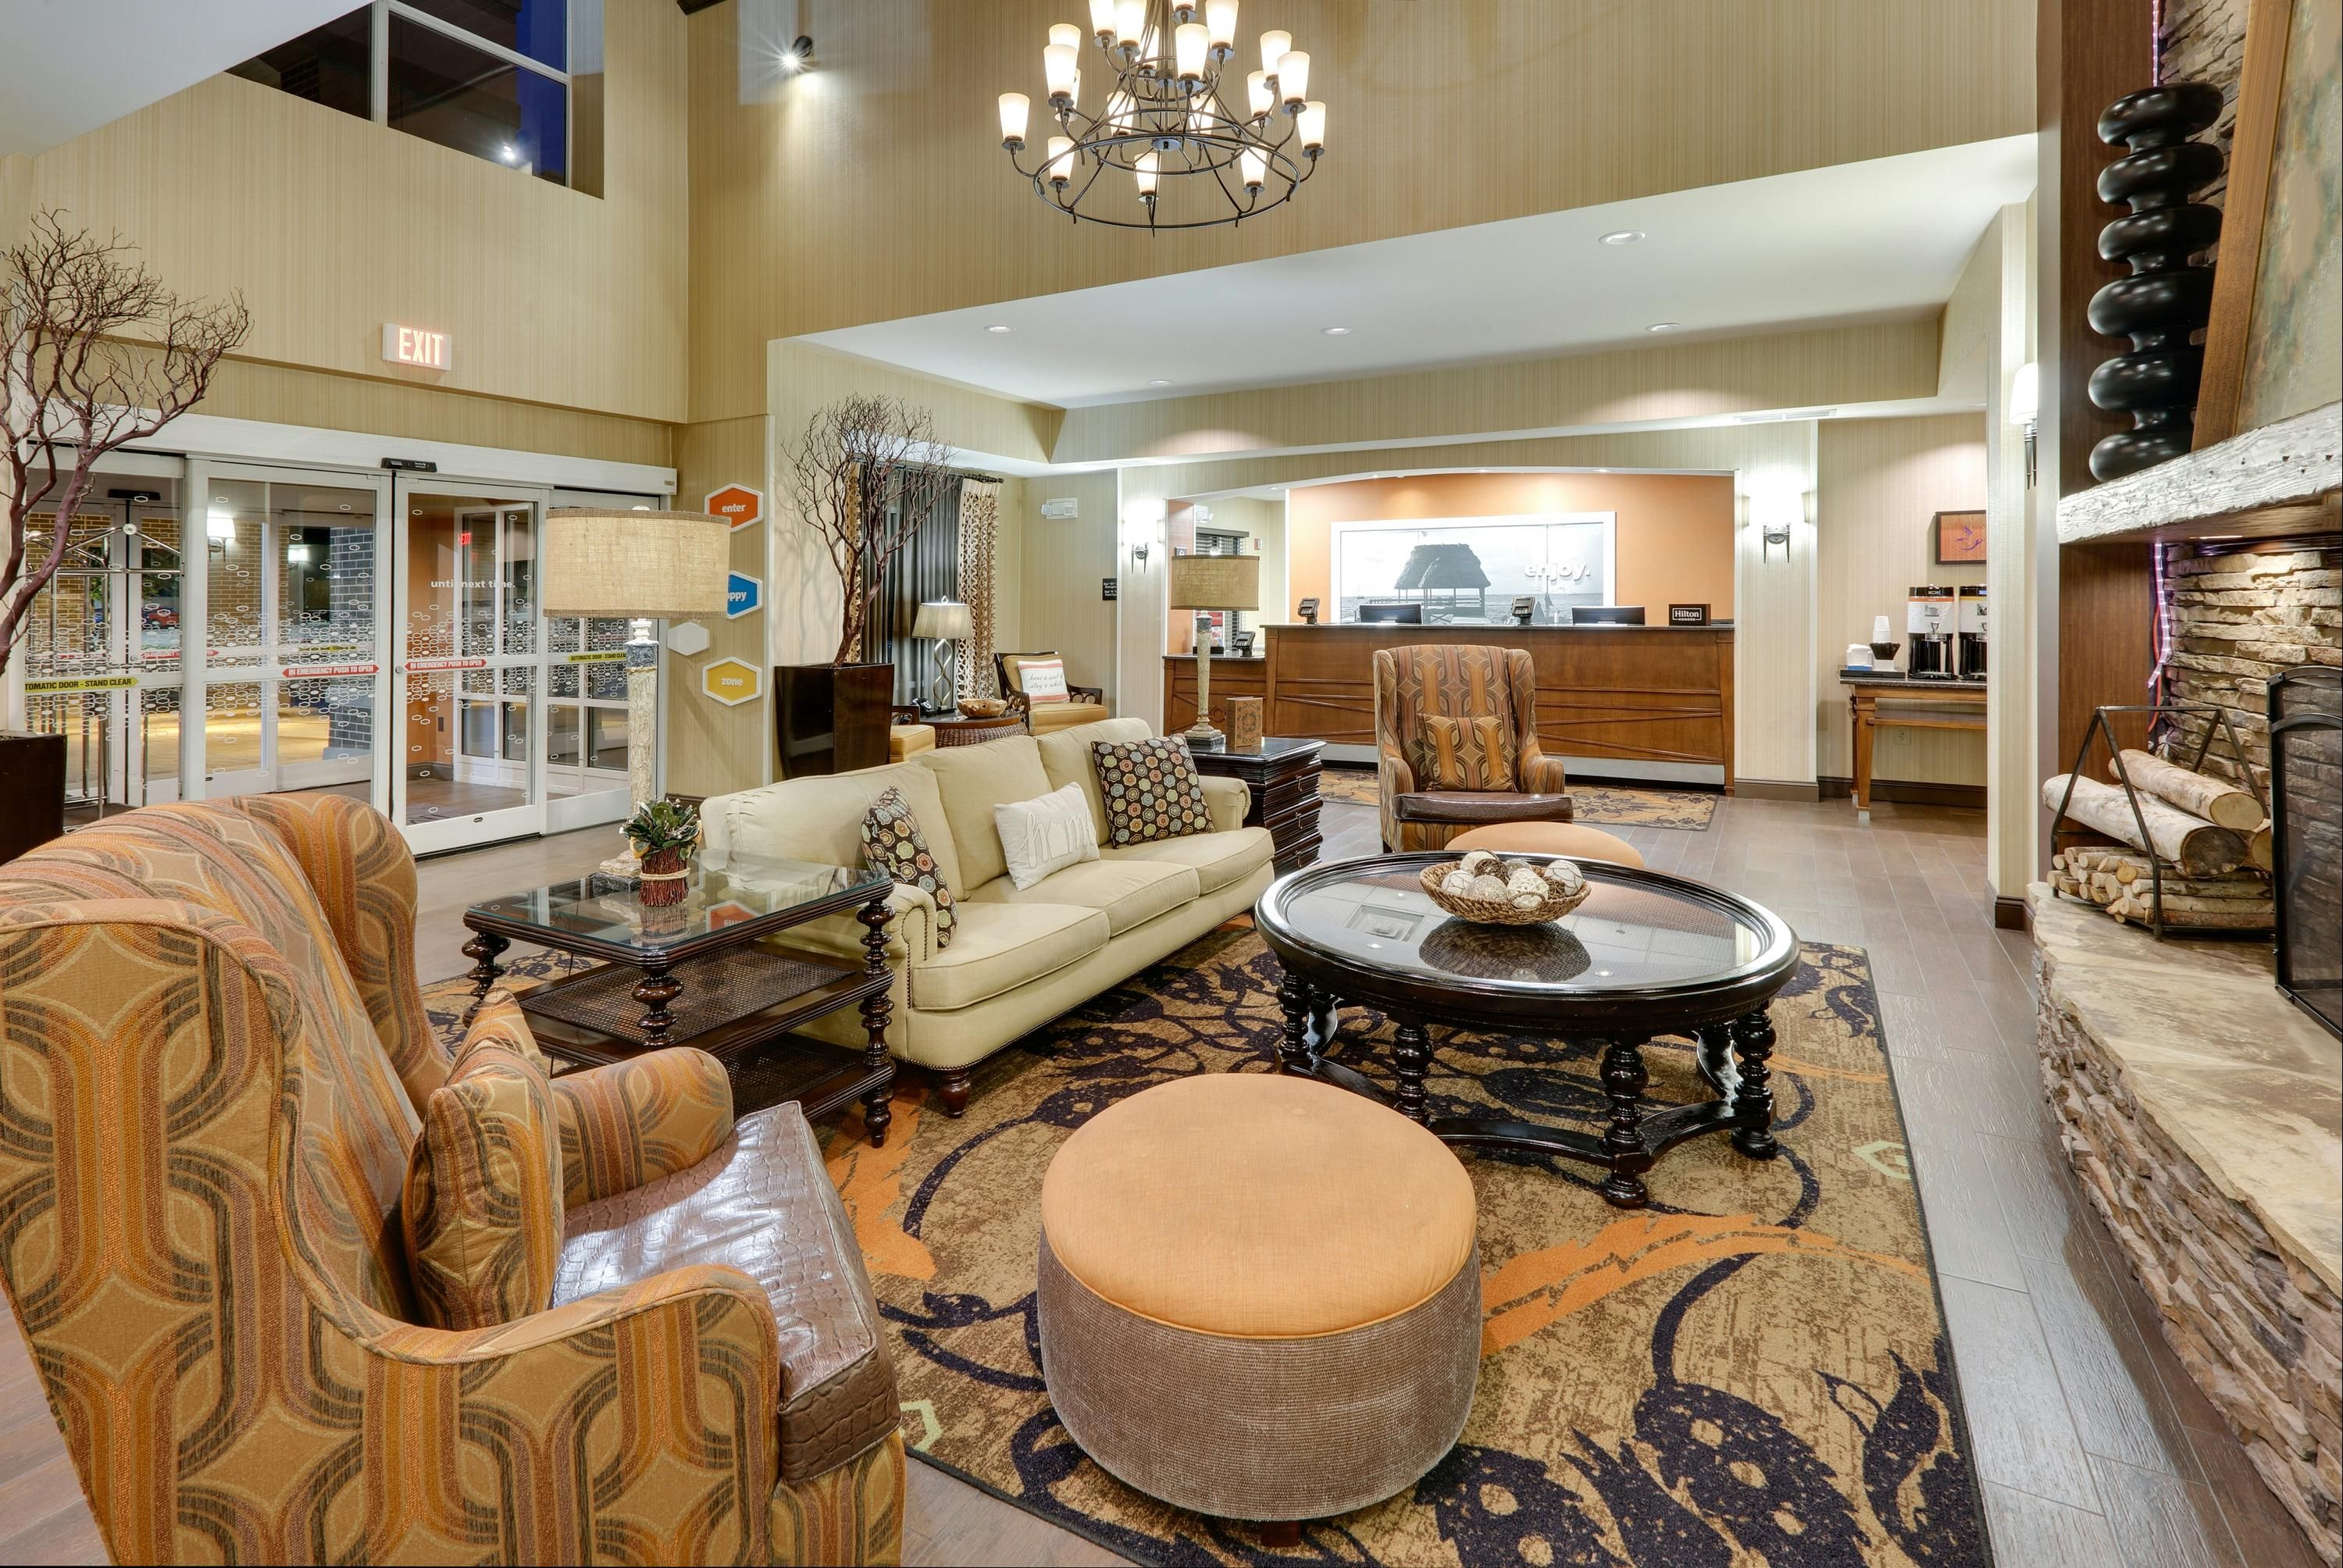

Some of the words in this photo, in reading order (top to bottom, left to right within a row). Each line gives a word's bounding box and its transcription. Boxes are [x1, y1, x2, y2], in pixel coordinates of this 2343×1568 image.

[398, 327, 444, 365] EXIT
[722, 503, 747, 513] enter
[1524, 560, 1591, 582] enjoy.
[430, 579, 455, 588] unti
[727, 591, 747, 602] ppy
[25, 682, 57, 690] TOMATIC
[721, 678, 743, 686] zone
[1020, 809, 1097, 868] hme
